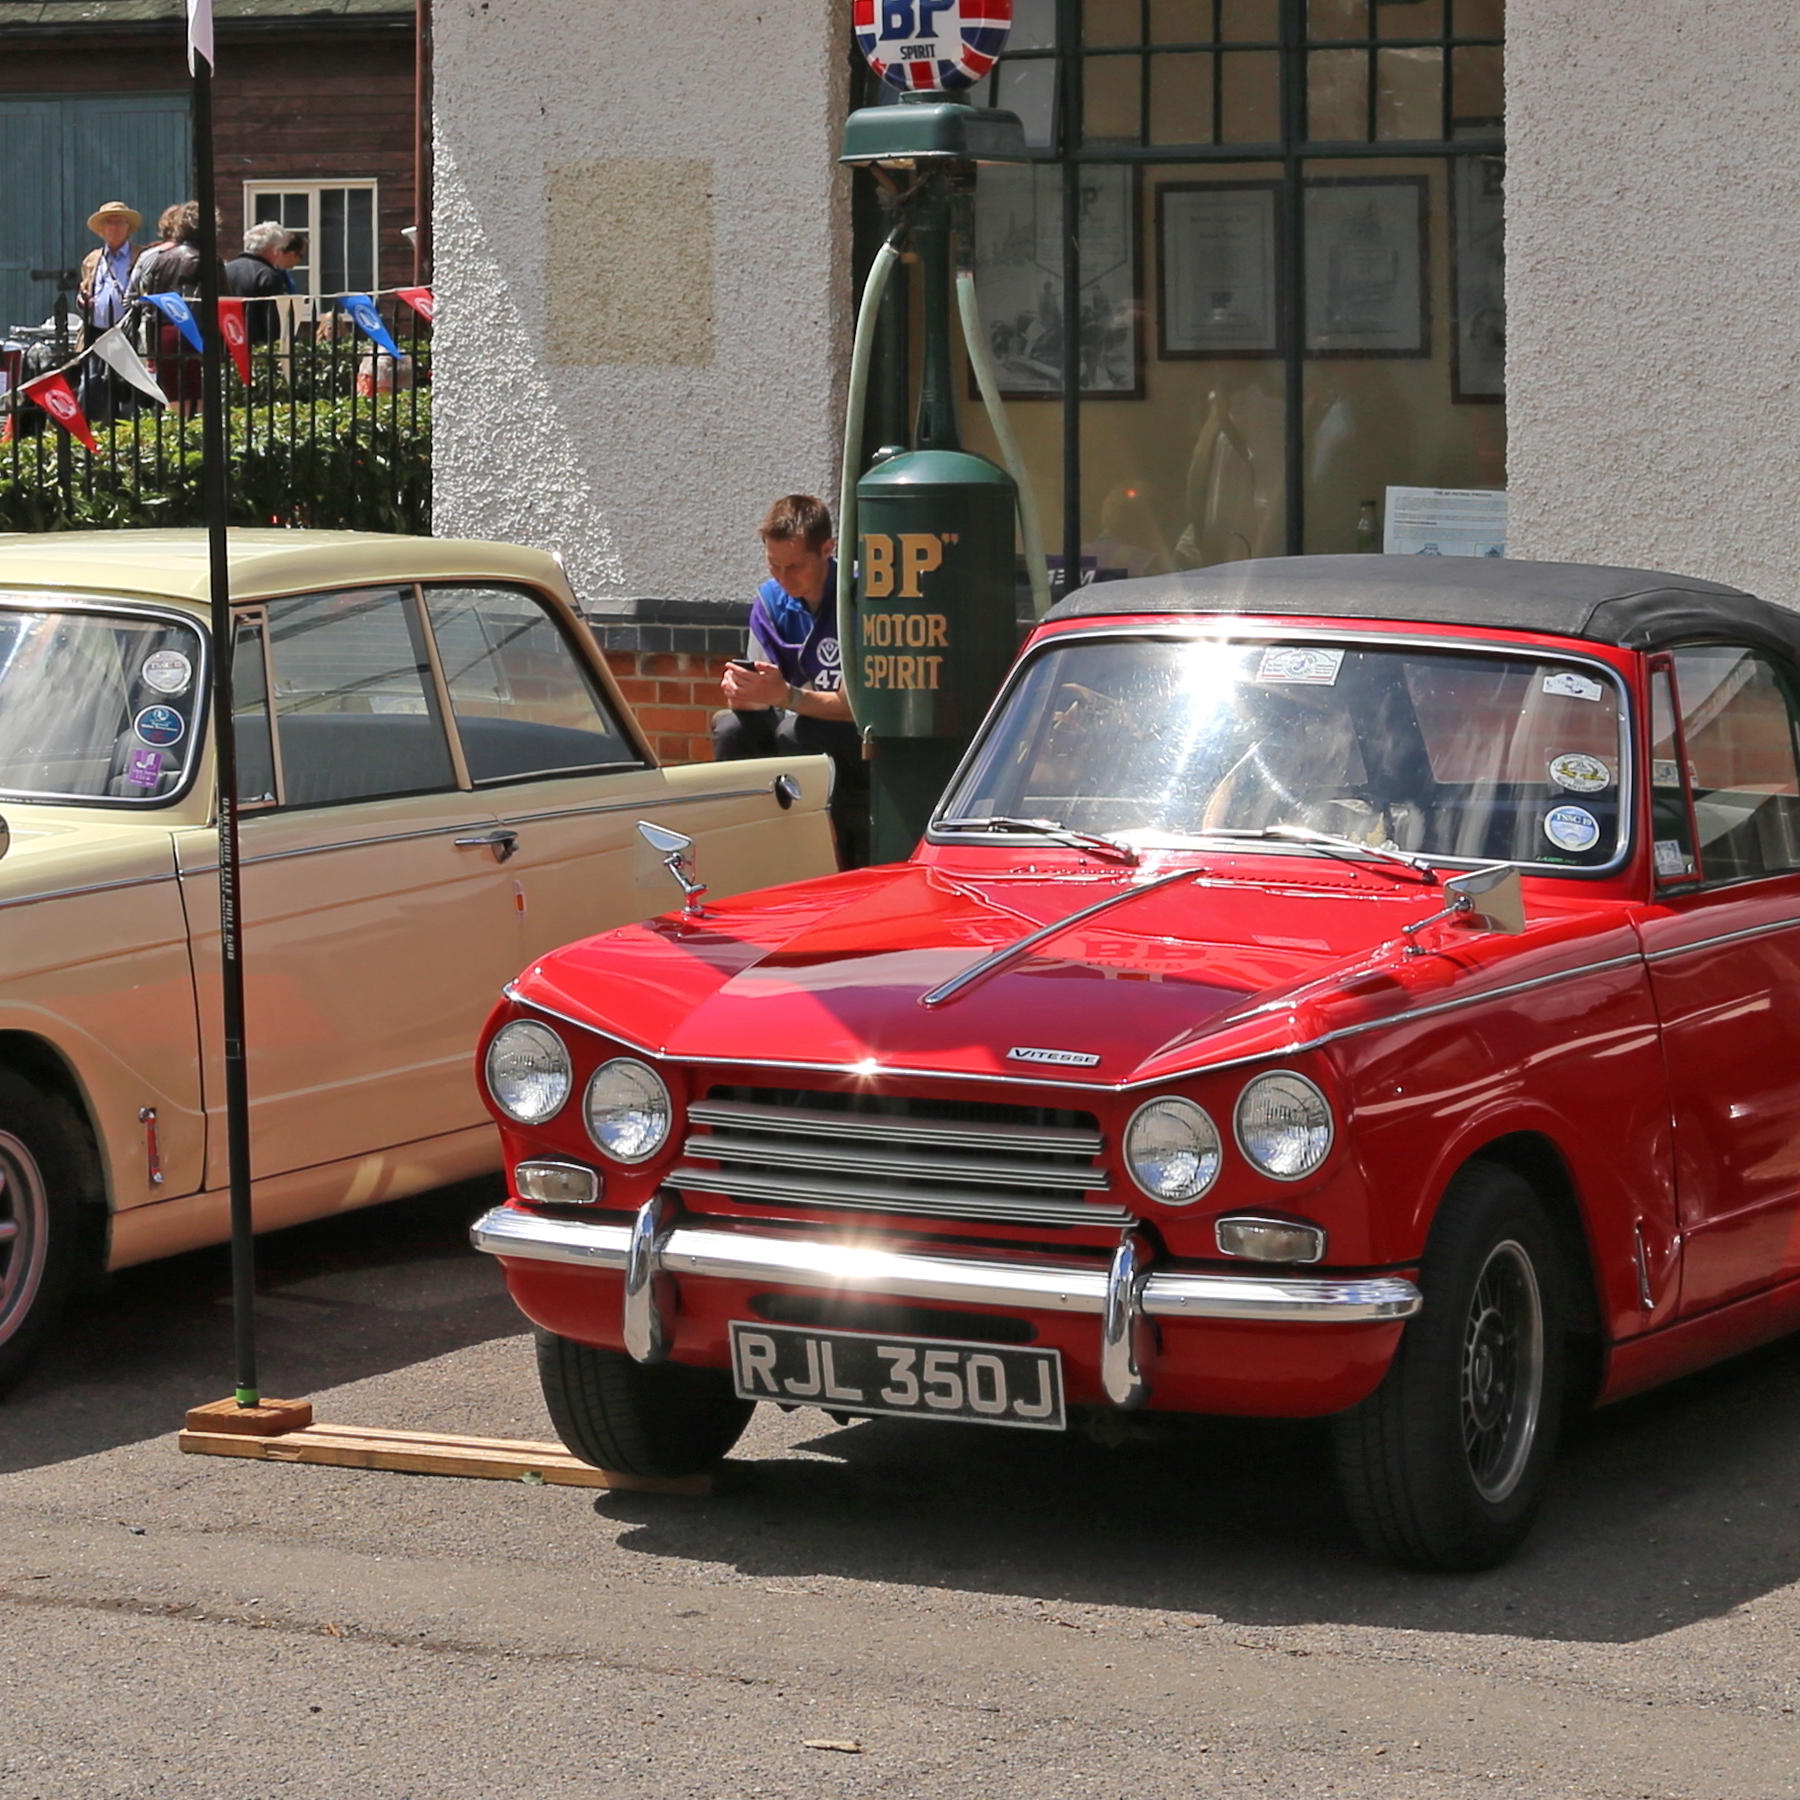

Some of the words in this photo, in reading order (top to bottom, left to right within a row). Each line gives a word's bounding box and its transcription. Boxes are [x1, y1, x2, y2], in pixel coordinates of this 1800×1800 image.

[899, 44, 936, 61] SPIRIT
[862, 613, 949, 648] MOTOR
[814, 669, 841, 690] 47
[864, 655, 944, 691] SPIRIT
[1014, 1048, 1098, 1064] VITESSE
[737, 1331, 864, 1401] RJL
[876, 1345, 1053, 1418] 350J
